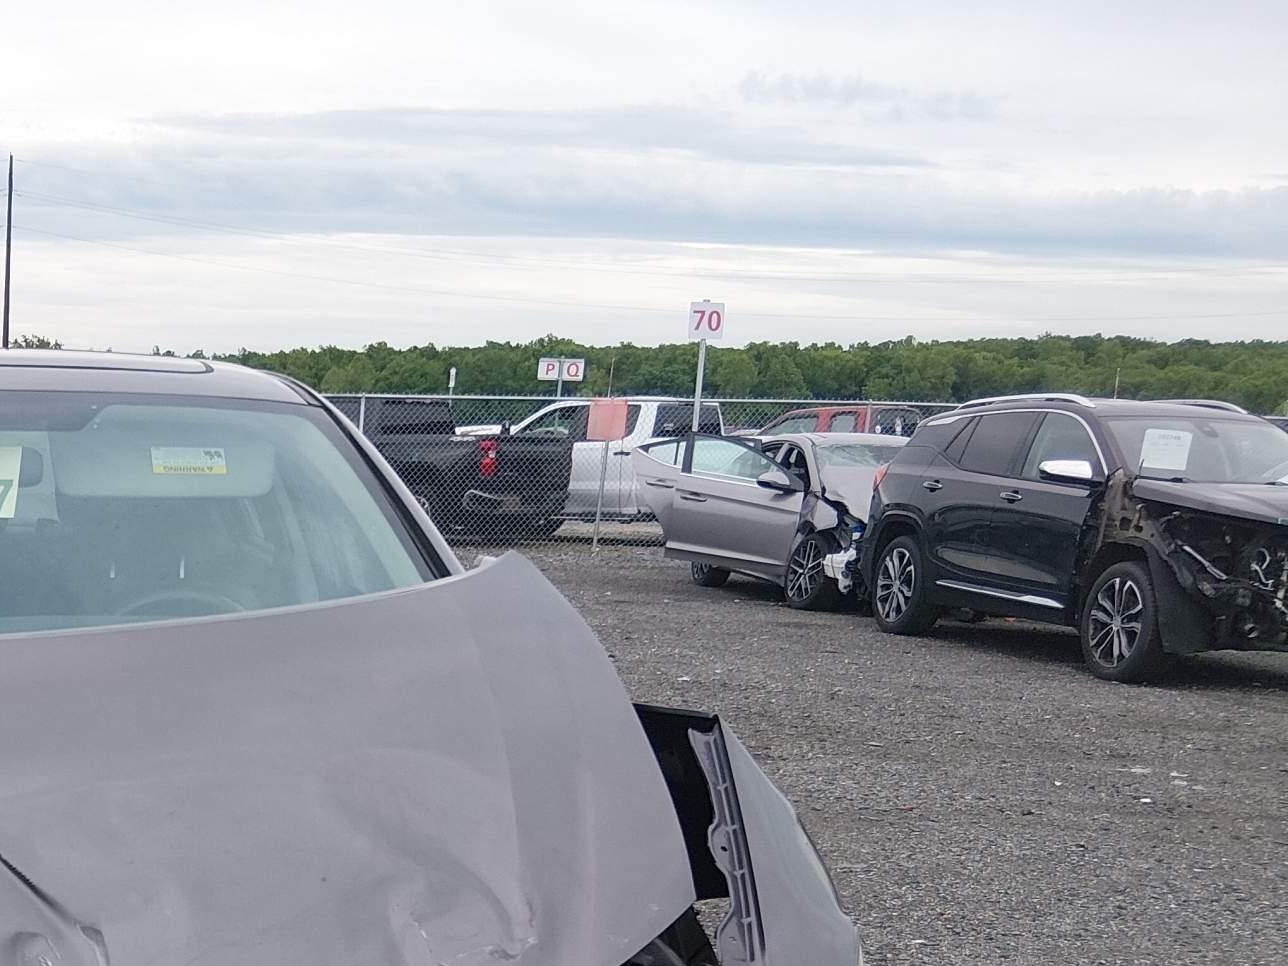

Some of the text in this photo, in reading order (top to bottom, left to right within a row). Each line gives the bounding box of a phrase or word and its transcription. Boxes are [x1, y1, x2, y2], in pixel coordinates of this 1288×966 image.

[693, 310, 721, 331] 70
[545, 363, 555, 375] P
[567, 362, 579, 377] Q
